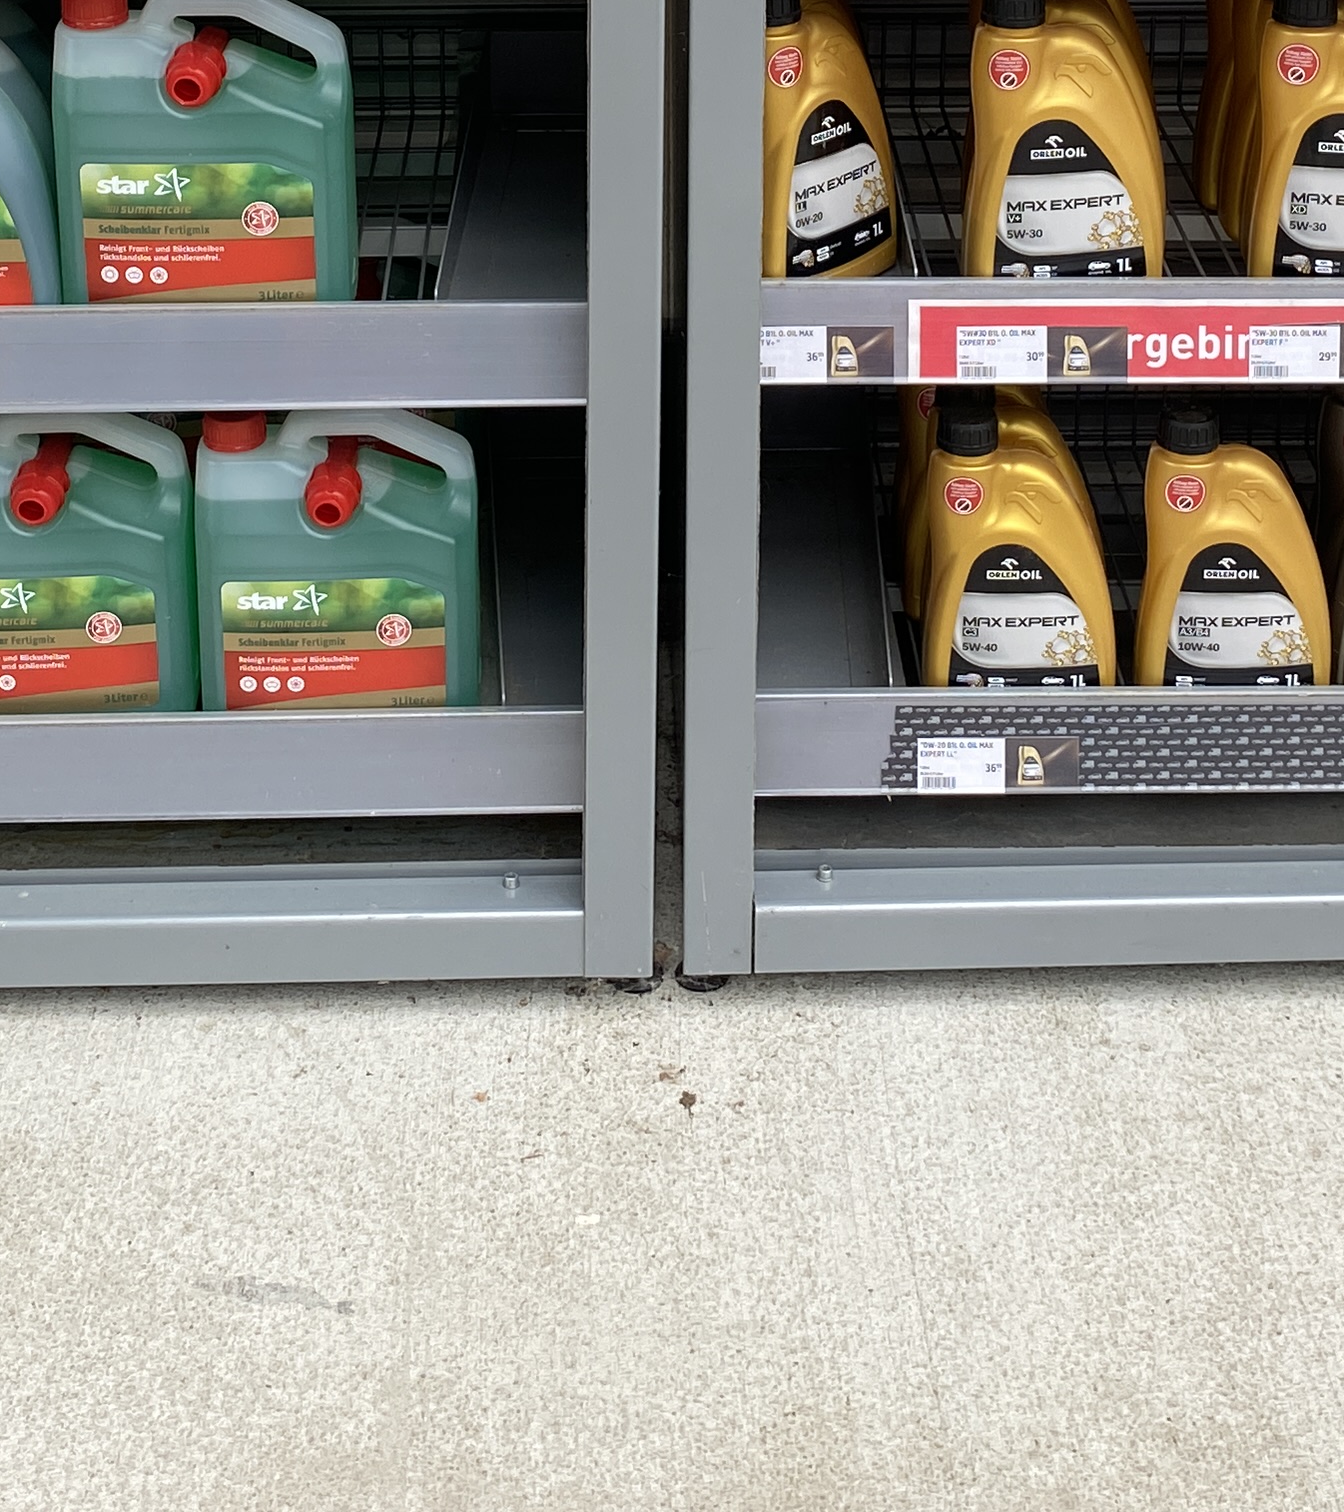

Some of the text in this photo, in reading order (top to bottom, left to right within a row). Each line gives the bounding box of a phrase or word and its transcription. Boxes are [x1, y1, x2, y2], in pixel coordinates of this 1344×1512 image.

[836, 122, 852, 136] OIL
[1065, 146, 1087, 158] OIL
[96, 175, 149, 196] star
[795, 159, 877, 203] MAX EXPERT
[1006, 193, 1125, 213] MAX EXPERT
[1290, 191, 1333, 205] MAX
[1291, 205, 1307, 214] XD
[795, 211, 824, 228] 0W-20
[1289, 220, 1327, 232] 5W-30
[872, 221, 884, 237] 1L
[1006, 228, 1043, 239] 5W-30
[1116, 257, 1133, 273] 1L
[1020, 569, 1042, 580] OIL
[1238, 569, 1260, 579] OIL
[236, 591, 288, 611] star
[962, 615, 1080, 628] MAX EXPERT
[1178, 614, 1296, 627] MAX EXPERT
[962, 642, 998, 652] 5W-40
[1177, 641, 1220, 652] 10W-40
